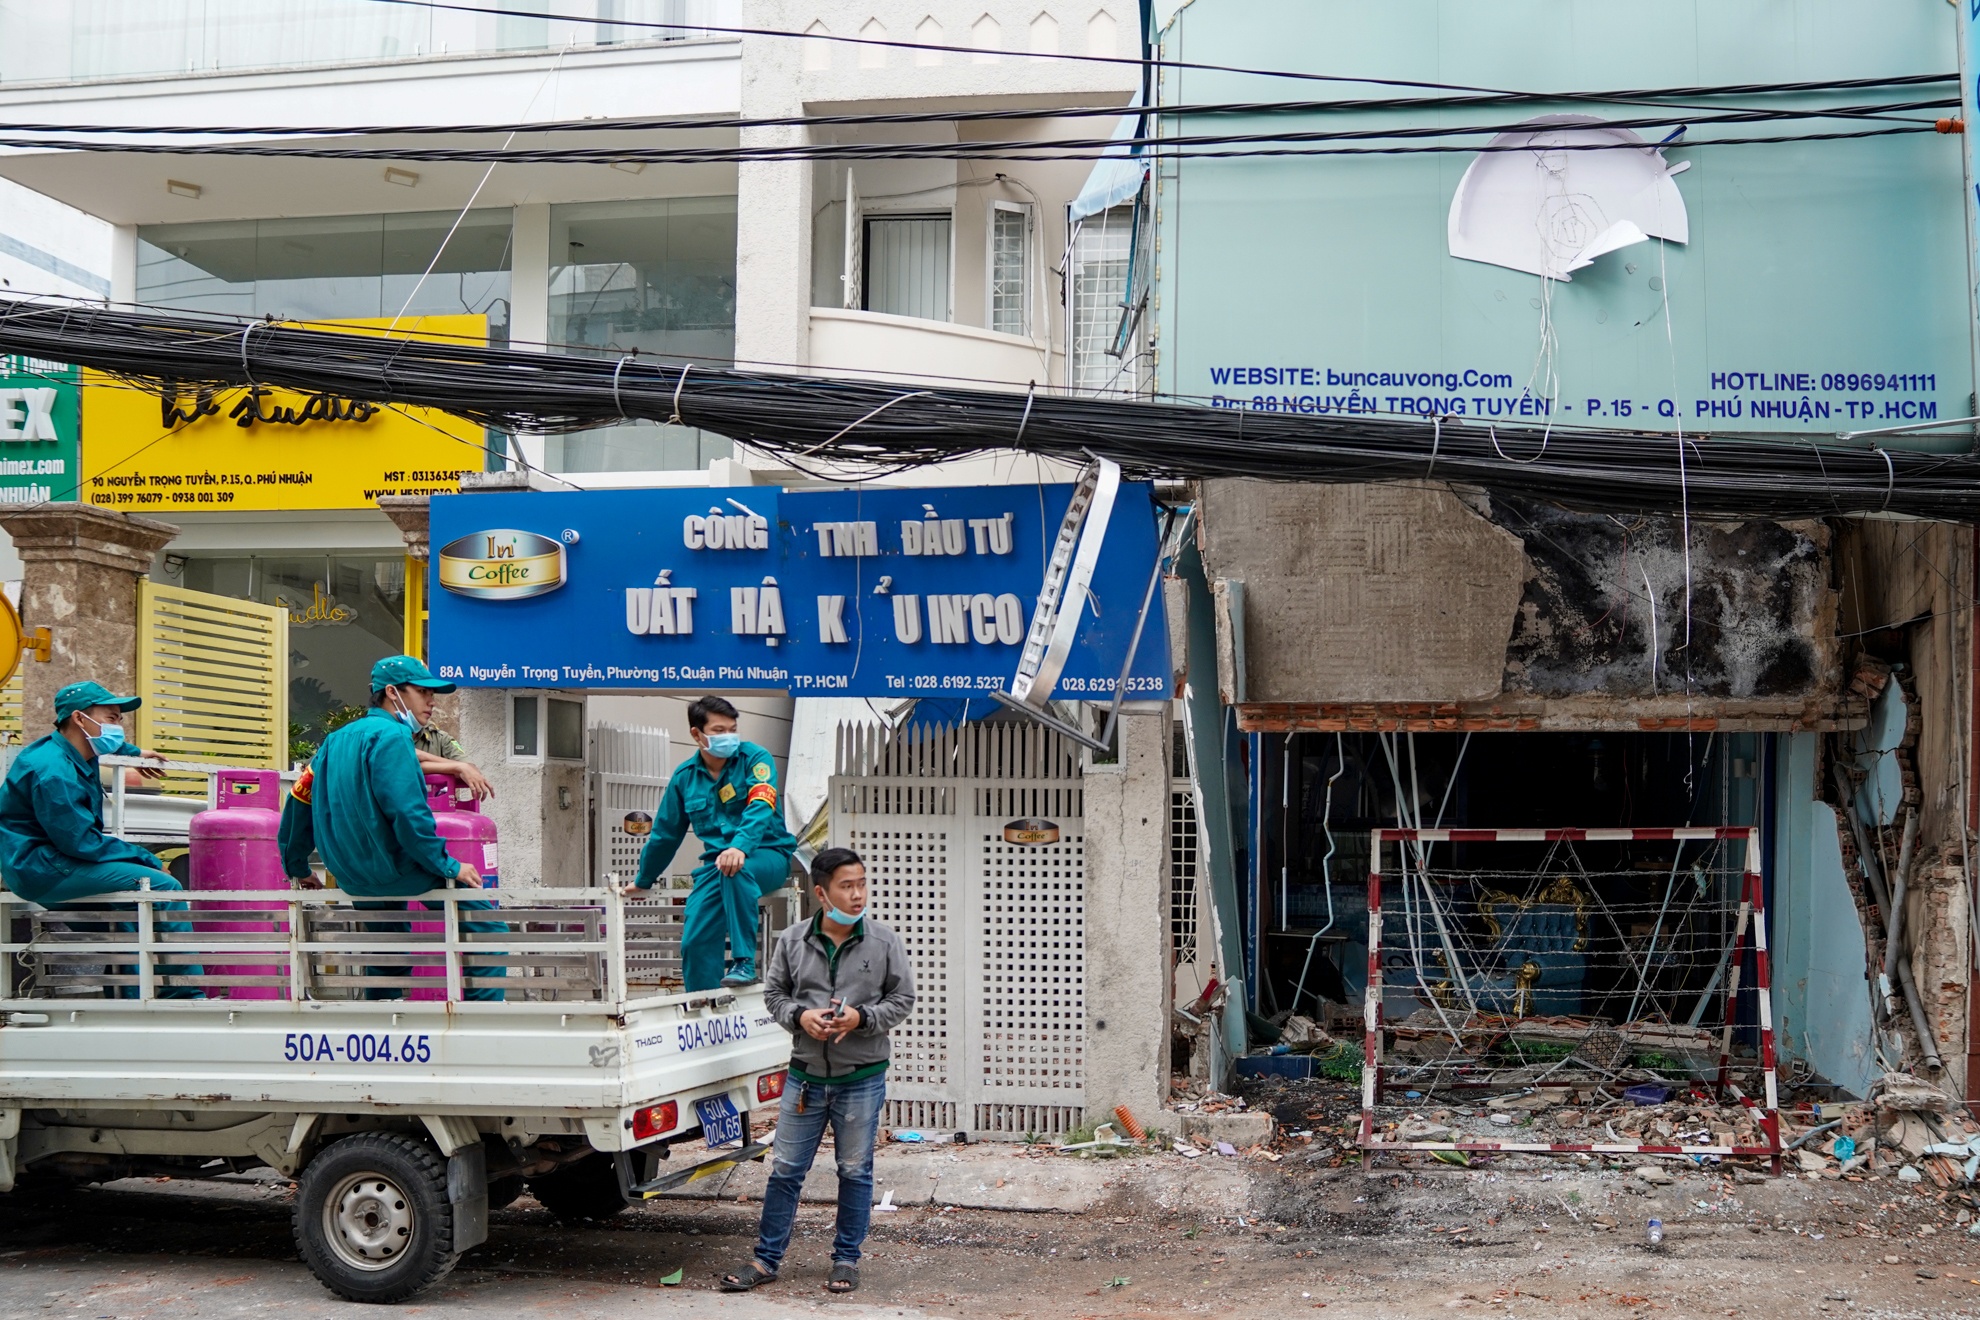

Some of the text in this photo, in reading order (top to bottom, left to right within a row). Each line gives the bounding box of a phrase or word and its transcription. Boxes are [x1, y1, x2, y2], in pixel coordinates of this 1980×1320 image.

[1210, 367, 1321, 386] WEBSITE:
[1711, 372, 1937, 392] HOTLINE: 0896941111
[1252, 395, 1278, 413] 88
[1282, 388, 1377, 414] NGUYỄN
[1385, 396, 1467, 420] TRỌNG
[1696, 395, 1741, 418] PHÚ
[1751, 395, 1830, 423] NHUẬN
[92, 477, 104, 487] 90
[107, 472, 146, 487] NGUYỄN
[149, 475, 182, 489] TRỌNG
[185, 470, 219, 486] TUYỂN,
[279, 471, 313, 486] NHUẬN
[384, 471, 405, 482] MST
[136, 493, 163, 503] 76079
[172, 492, 195, 503] 0938
[198, 492, 214, 503] 001
[217, 492, 235, 503] 309
[901, 503, 967, 556] ĐẦU
[968, 511, 1014, 555] TƯ
[468, 563, 530, 585] Coffee
[625, 569, 698, 635] UẤT
[730, 575, 787, 647] HẬ
[439, 665, 464, 678] 88A
[470, 663, 516, 681] Nguyễn
[521, 665, 558, 681] Trọng
[718, 666, 743, 679] Phú
[793, 675, 848, 688] TP.HCM
[885, 675, 905, 689] Tel
[634, 1034, 664, 1050] THACO
[677, 1013, 749, 1053] 50A-004.65
[284, 1033, 432, 1064] 50A-004.65
[703, 1099, 730, 1122] 50A
[704, 1114, 742, 1147] 004.65
